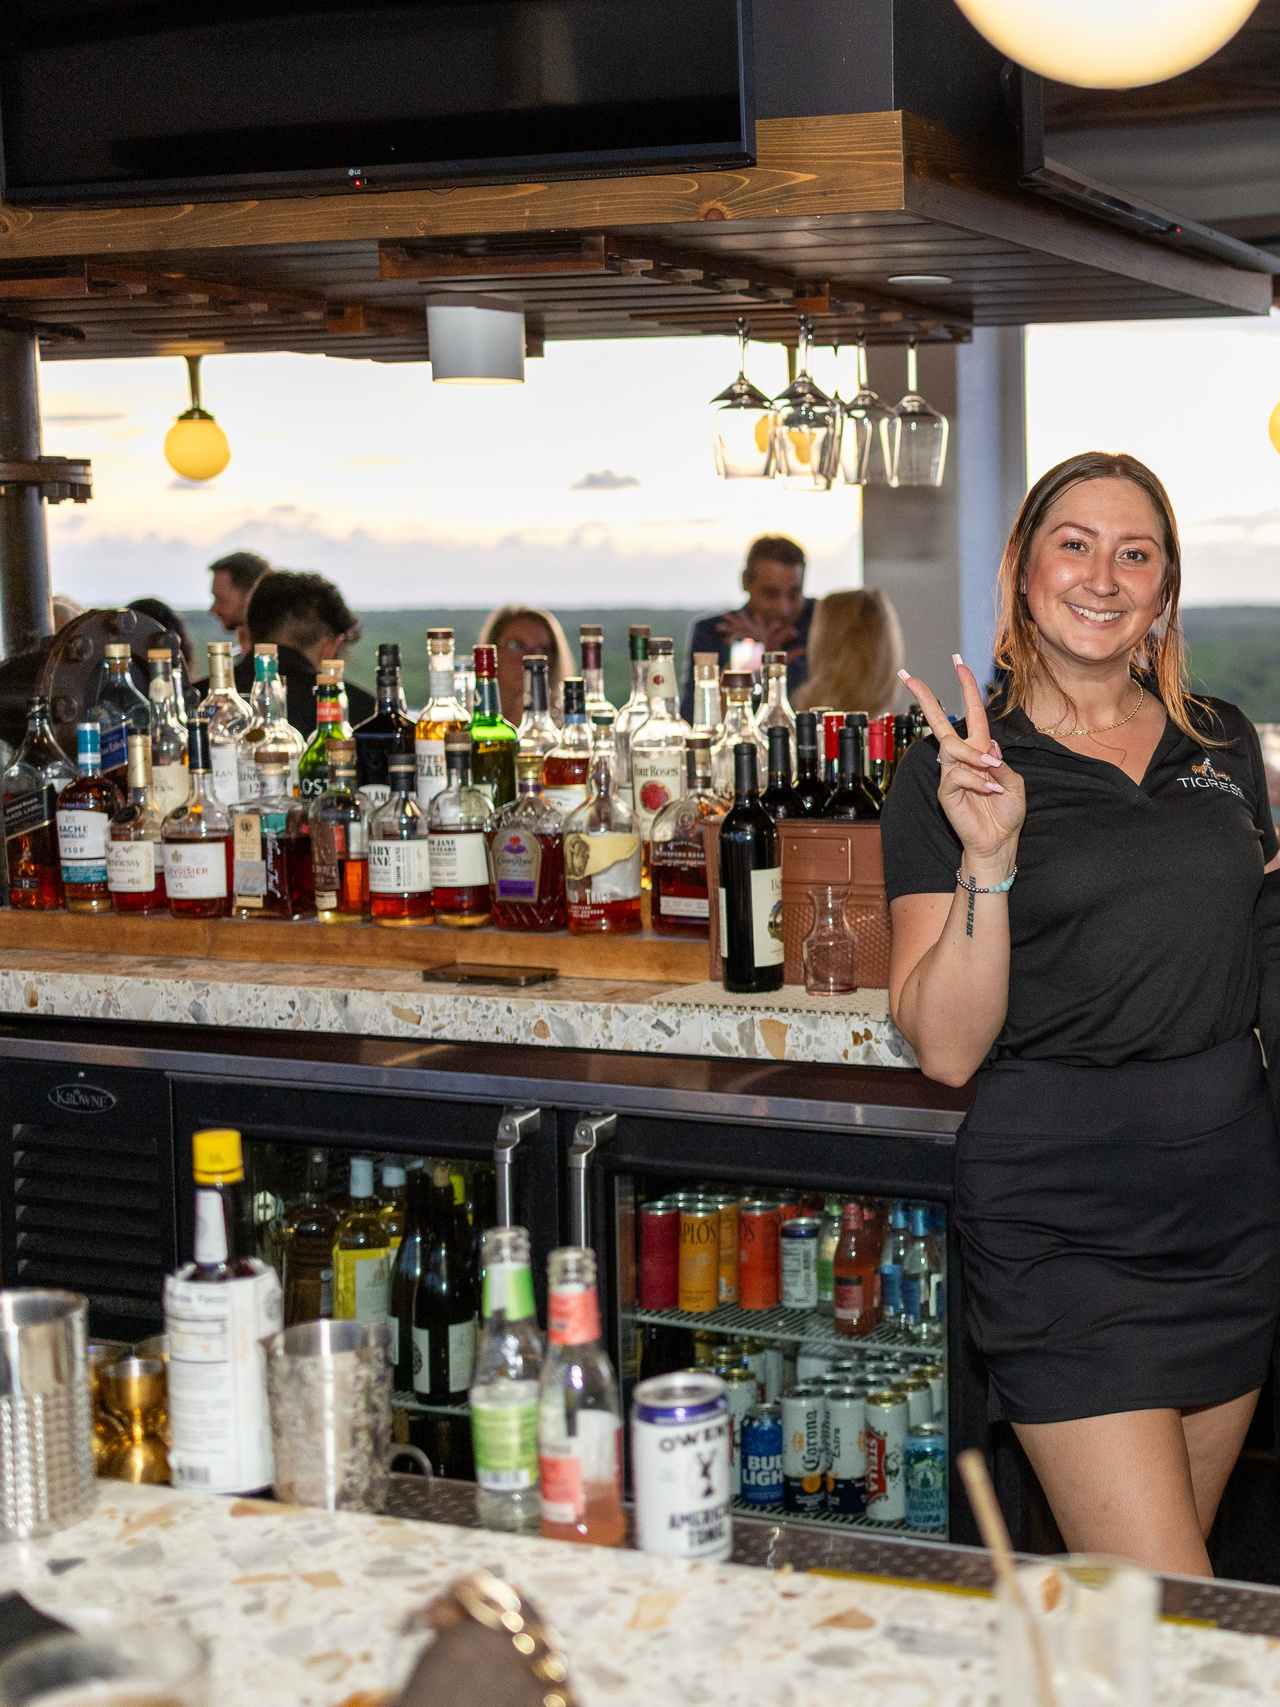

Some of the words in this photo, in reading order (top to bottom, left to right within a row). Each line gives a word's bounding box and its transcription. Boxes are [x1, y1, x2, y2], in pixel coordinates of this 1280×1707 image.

[650, 765, 679, 777] Roses
[1177, 777, 1244, 800] TIGRESS
[803, 1409, 818, 1472] Corona
[742, 1467, 783, 1487] LIGH
